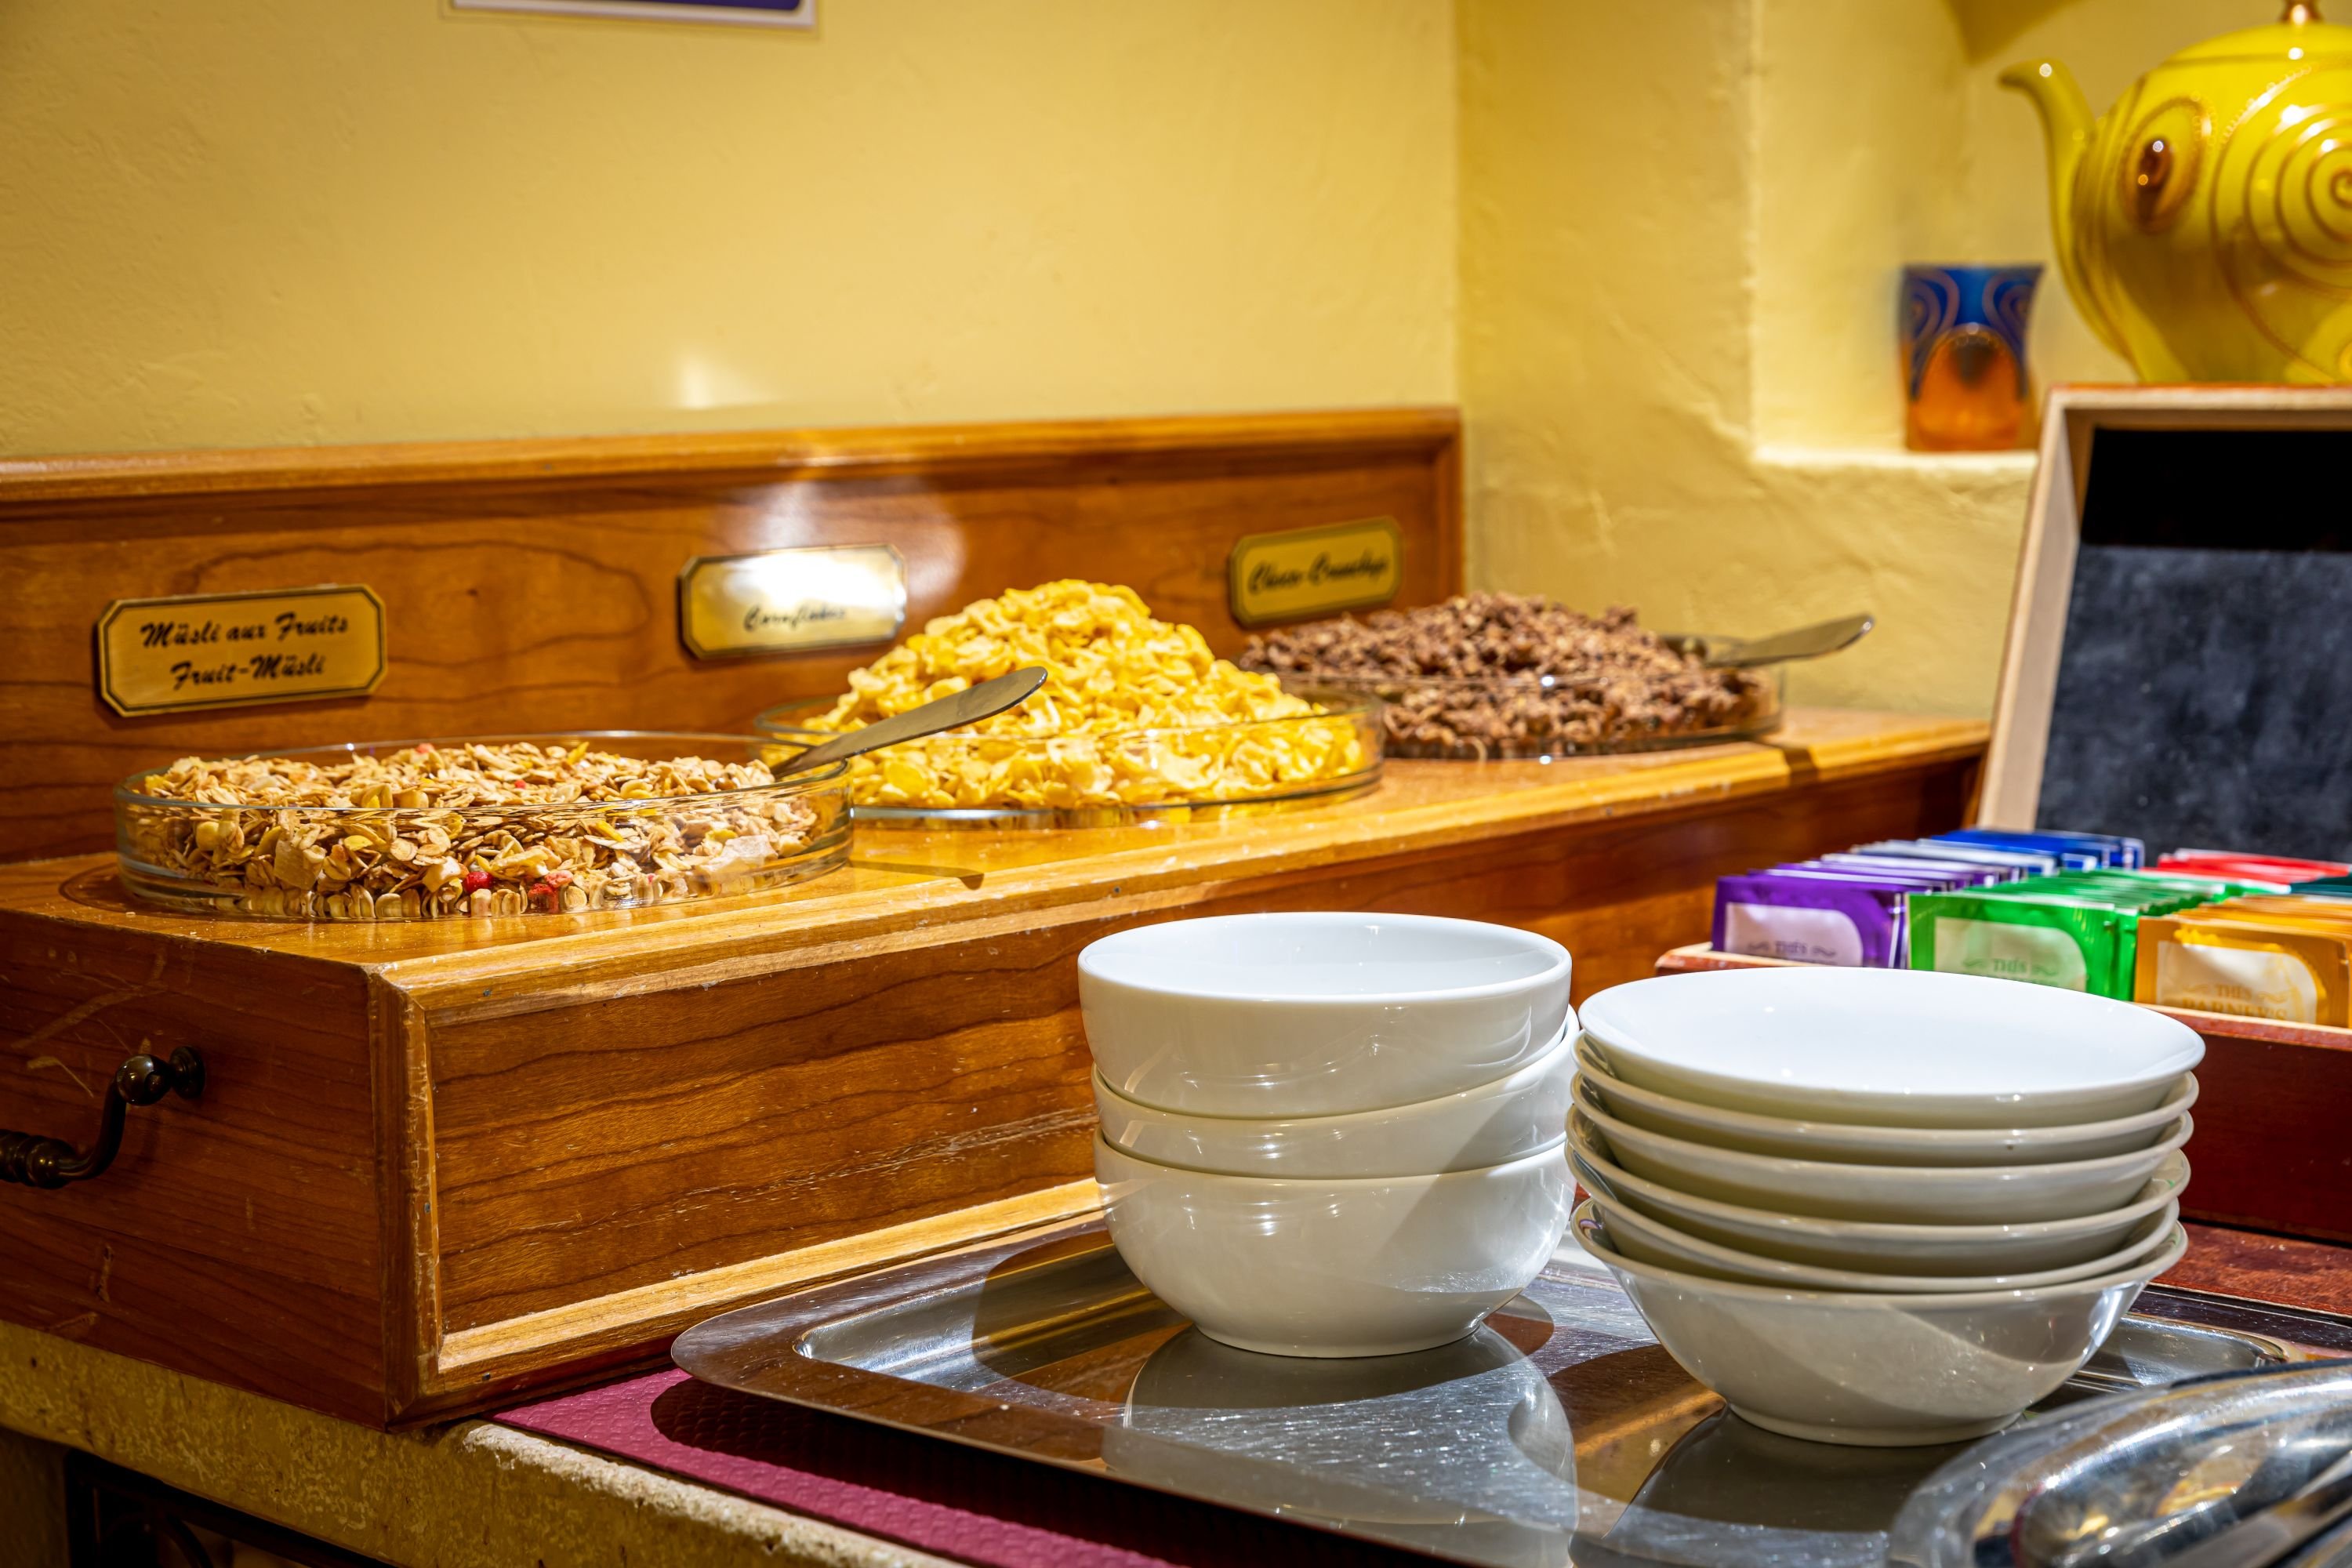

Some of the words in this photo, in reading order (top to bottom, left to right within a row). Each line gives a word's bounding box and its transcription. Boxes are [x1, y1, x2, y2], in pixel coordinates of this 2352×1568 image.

[140, 620, 221, 648] Müsli
[226, 622, 267, 643] aux
[274, 612, 349, 641] Fruits
[170, 652, 326, 691] Fruit-Müsli
